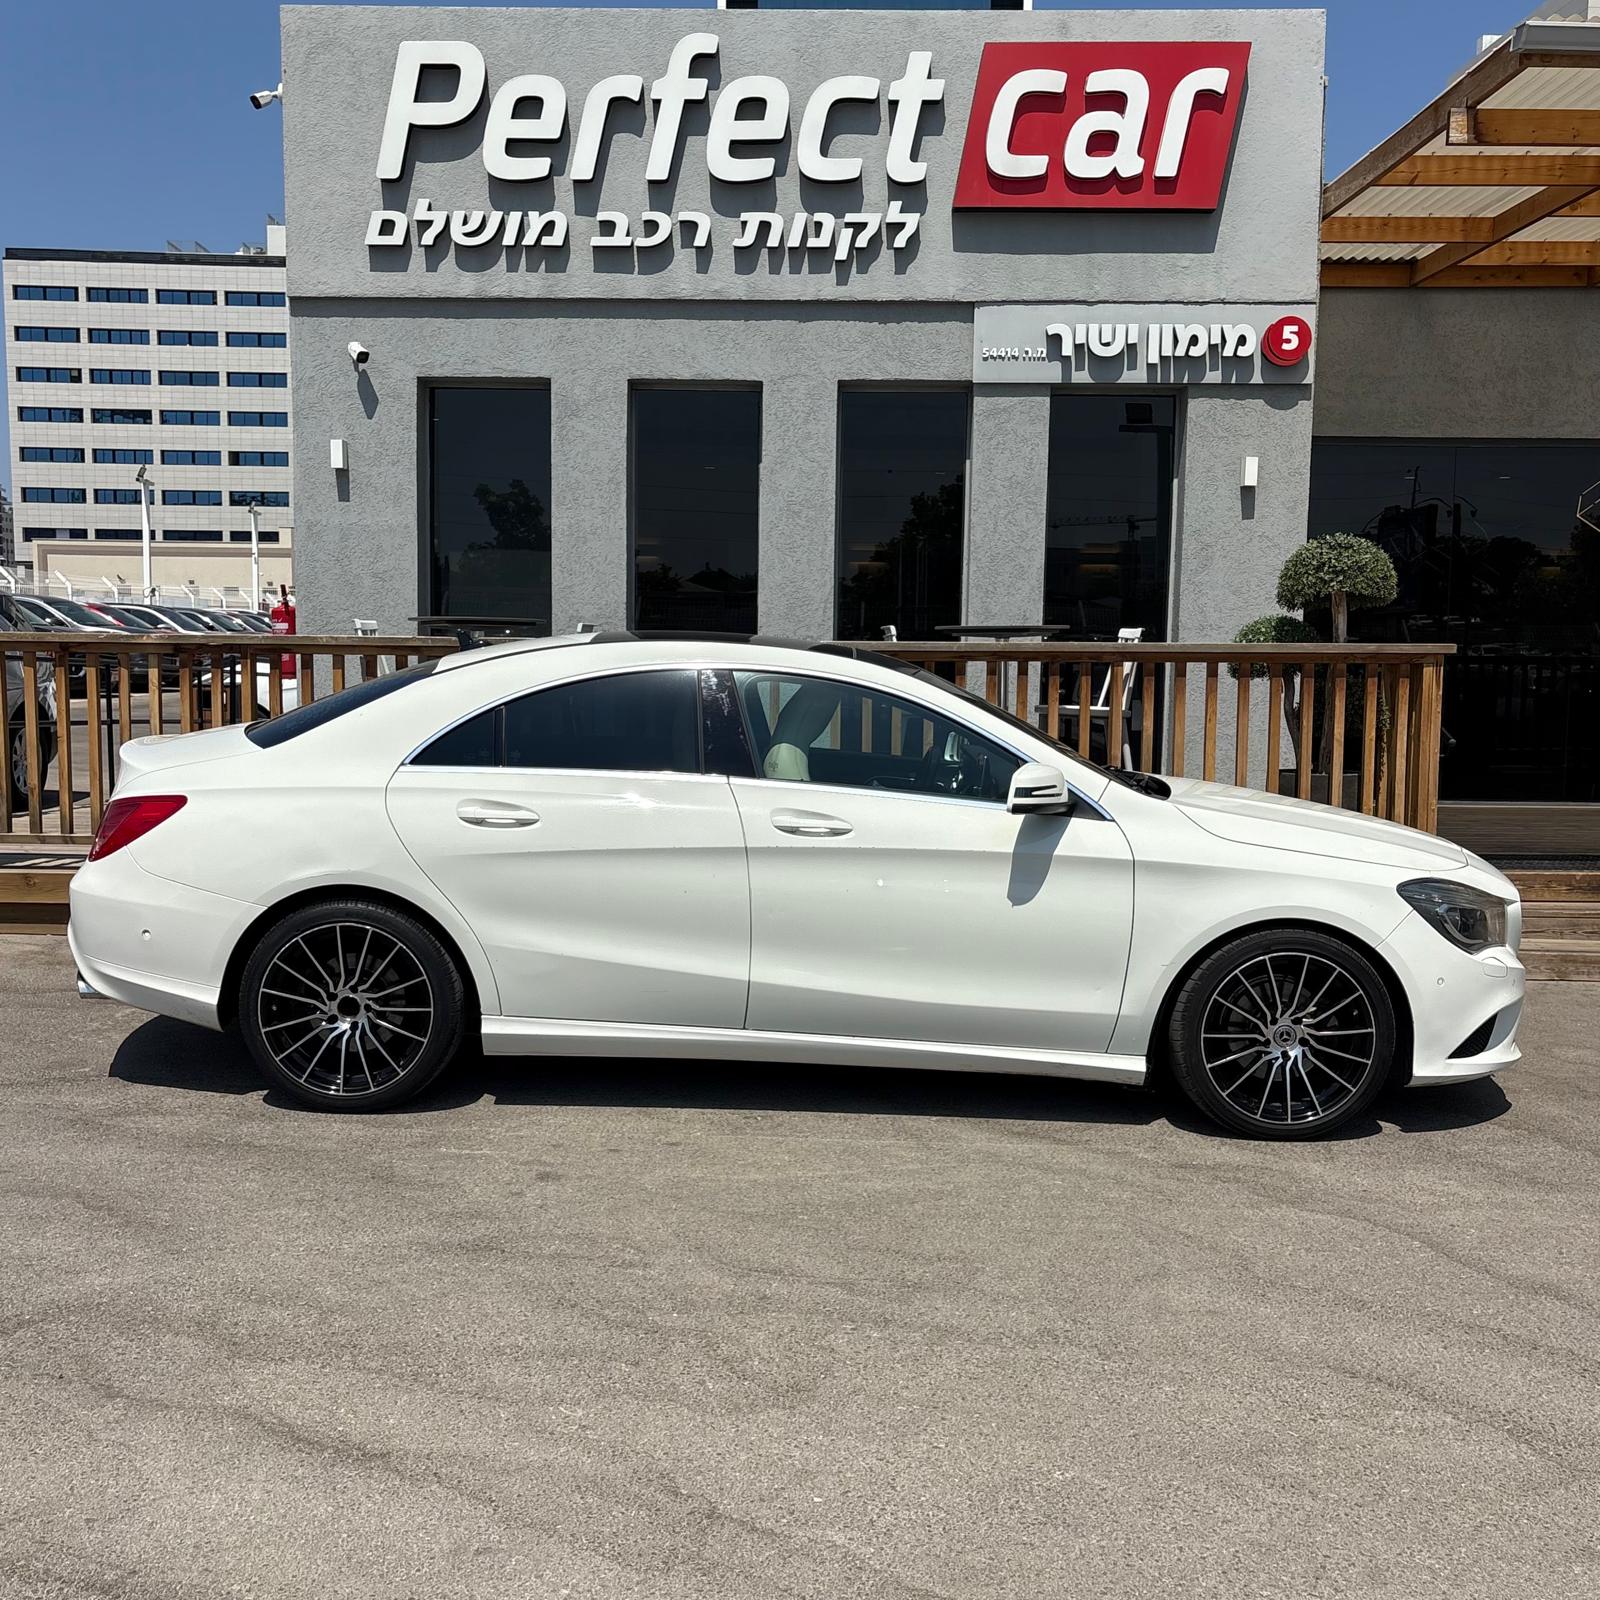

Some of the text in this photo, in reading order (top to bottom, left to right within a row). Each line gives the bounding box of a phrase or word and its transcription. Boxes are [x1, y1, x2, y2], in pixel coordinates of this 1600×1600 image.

[376, 32, 1229, 182] Perfect car
[364, 198, 921, 261] לקנות רכב מושלם
[982, 347, 1019, 357] 54414
[1046, 323, 1300, 364] 5 מימון ישיר
